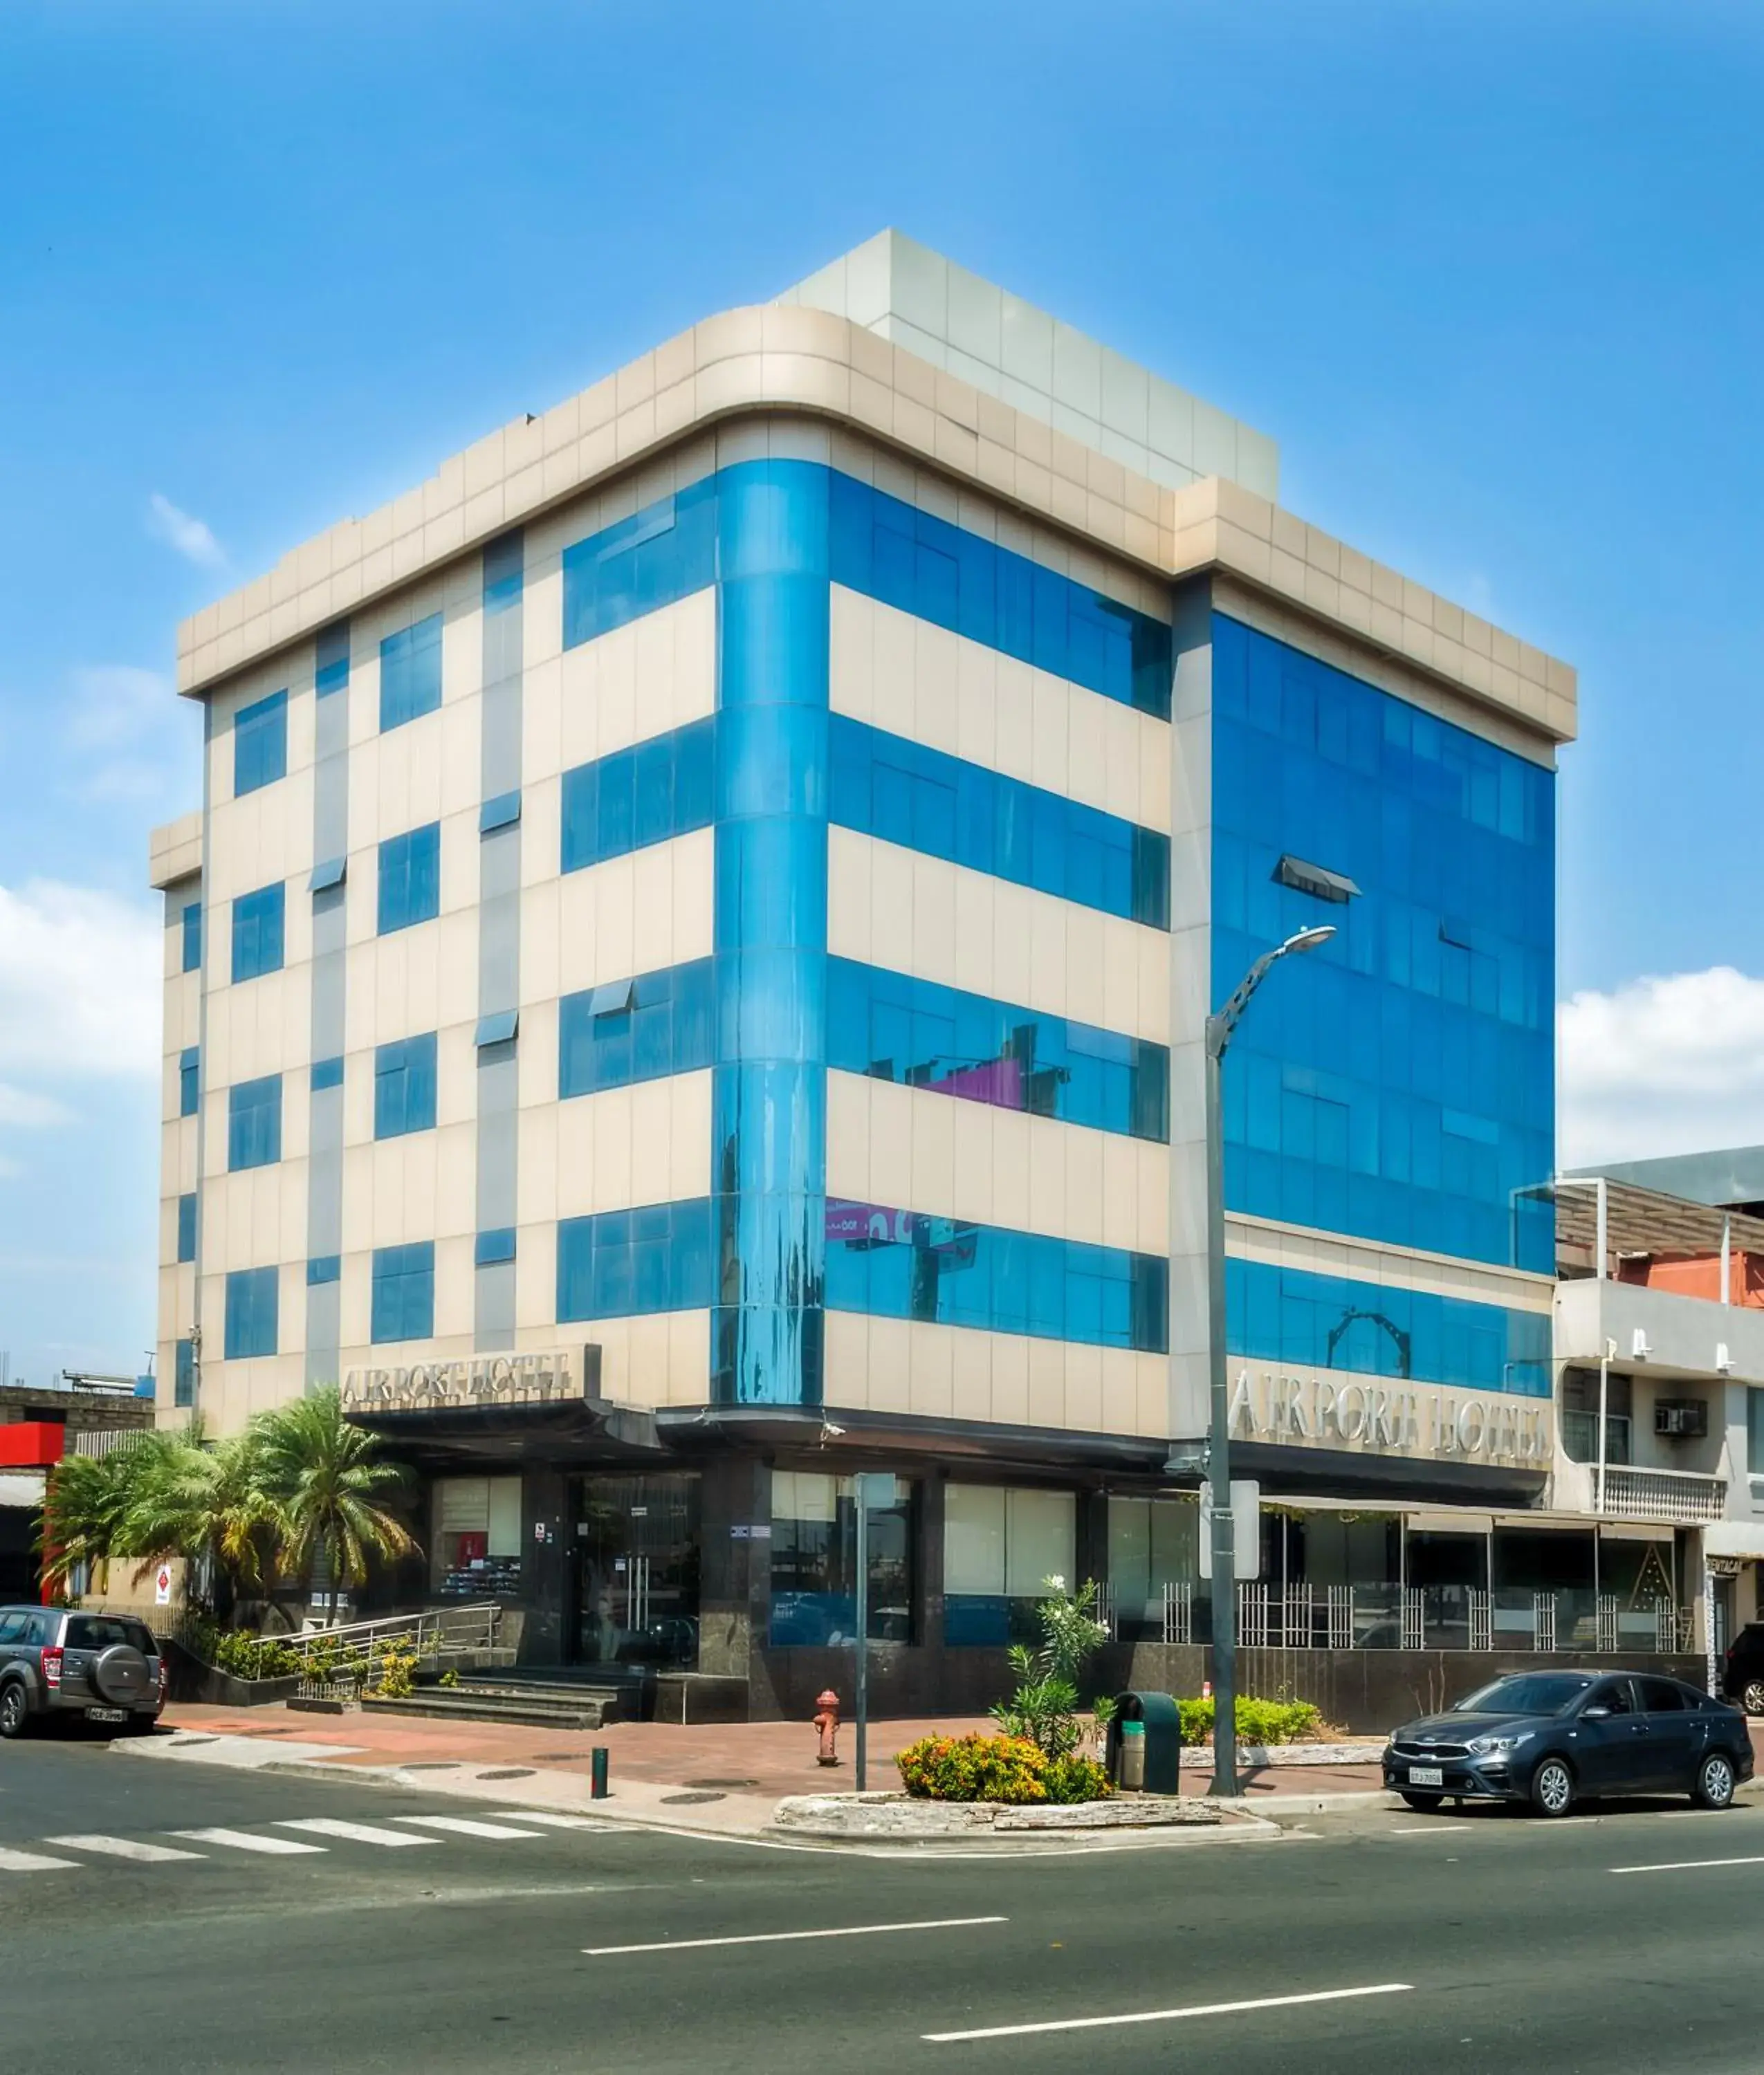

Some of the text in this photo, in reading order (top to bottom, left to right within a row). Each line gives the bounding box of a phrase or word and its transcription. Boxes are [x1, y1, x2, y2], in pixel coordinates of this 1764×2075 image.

[342, 1353, 571, 1404] AIRPORT HOTEL
[1228, 1370, 1552, 1460] AIRPORT HOTEL
